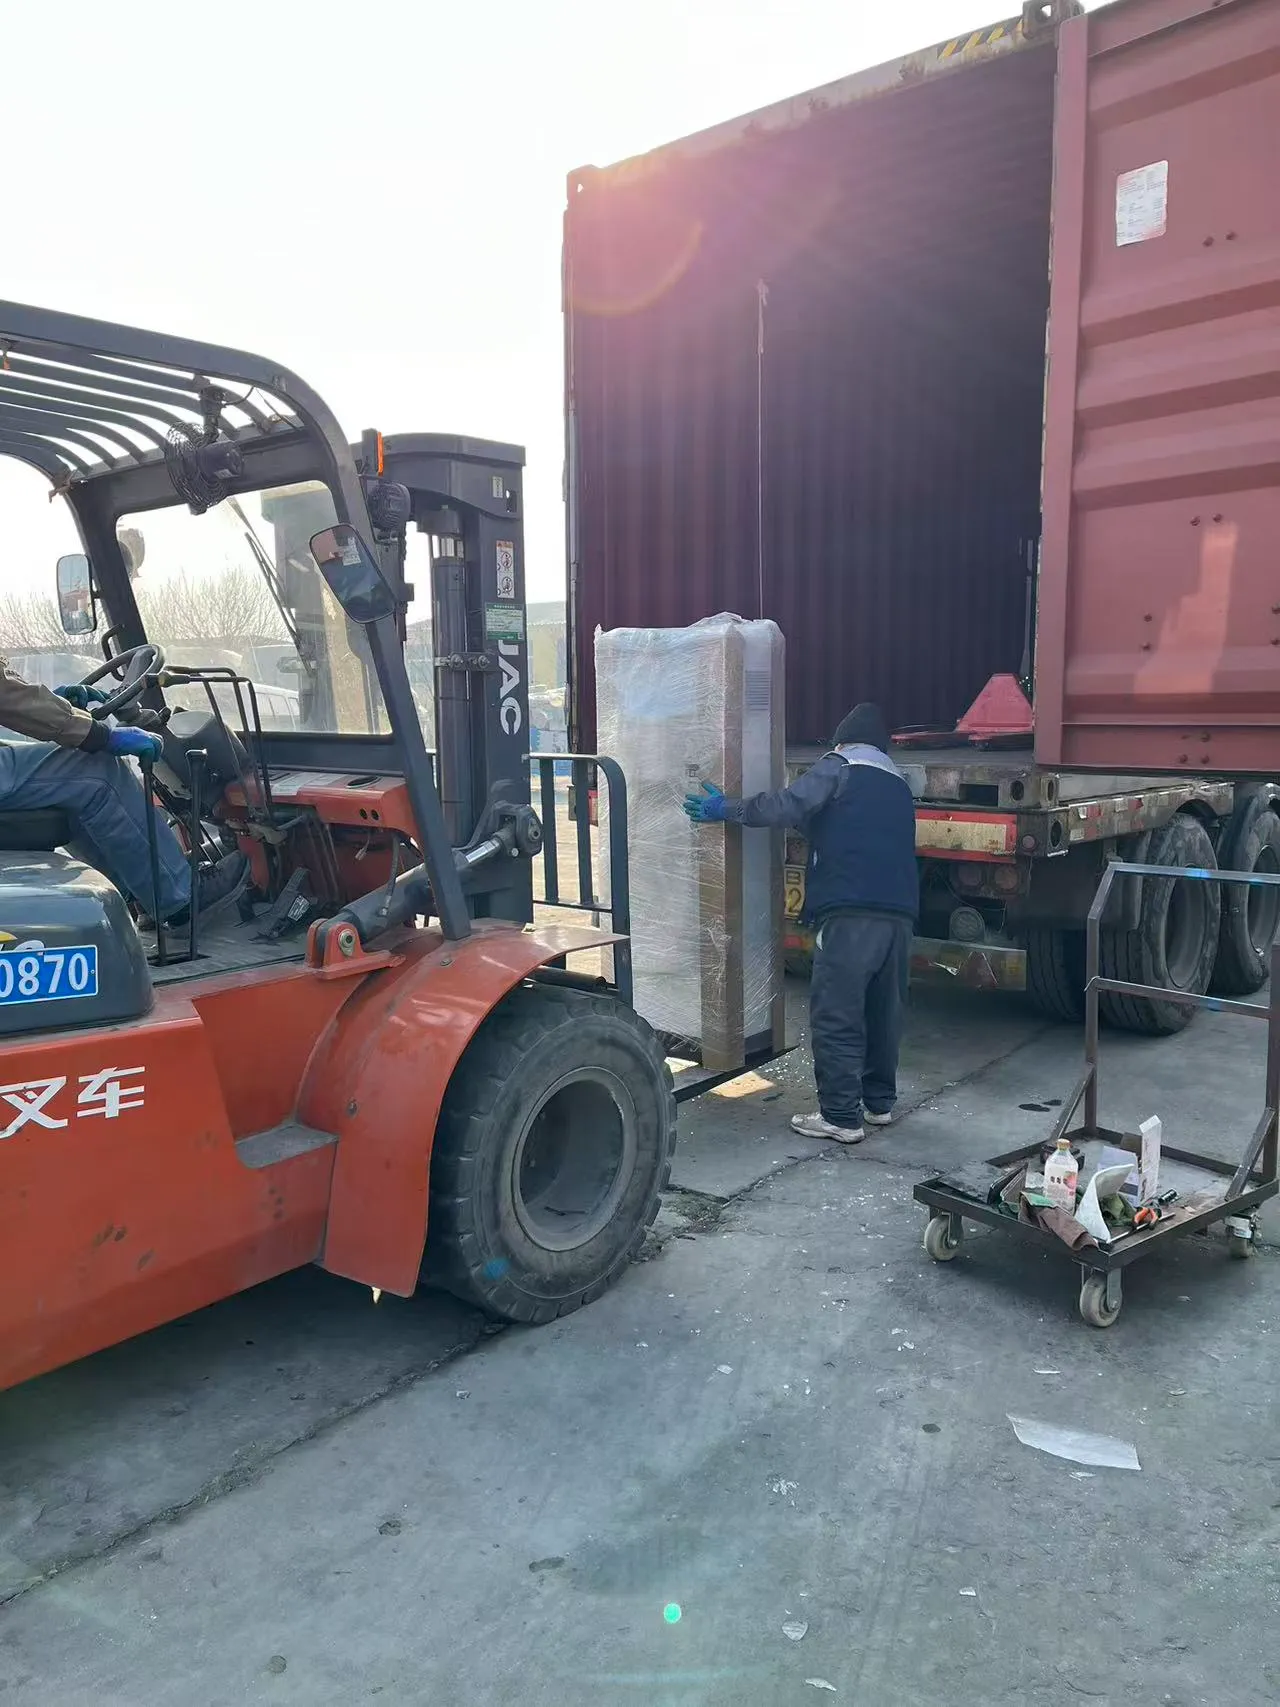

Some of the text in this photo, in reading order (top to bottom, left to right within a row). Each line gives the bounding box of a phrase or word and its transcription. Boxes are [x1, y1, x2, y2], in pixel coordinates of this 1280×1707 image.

[498, 639, 521, 735] JAC
[0, 953, 88, 998] 0870
[0, 1066, 145, 1139] 叉车
